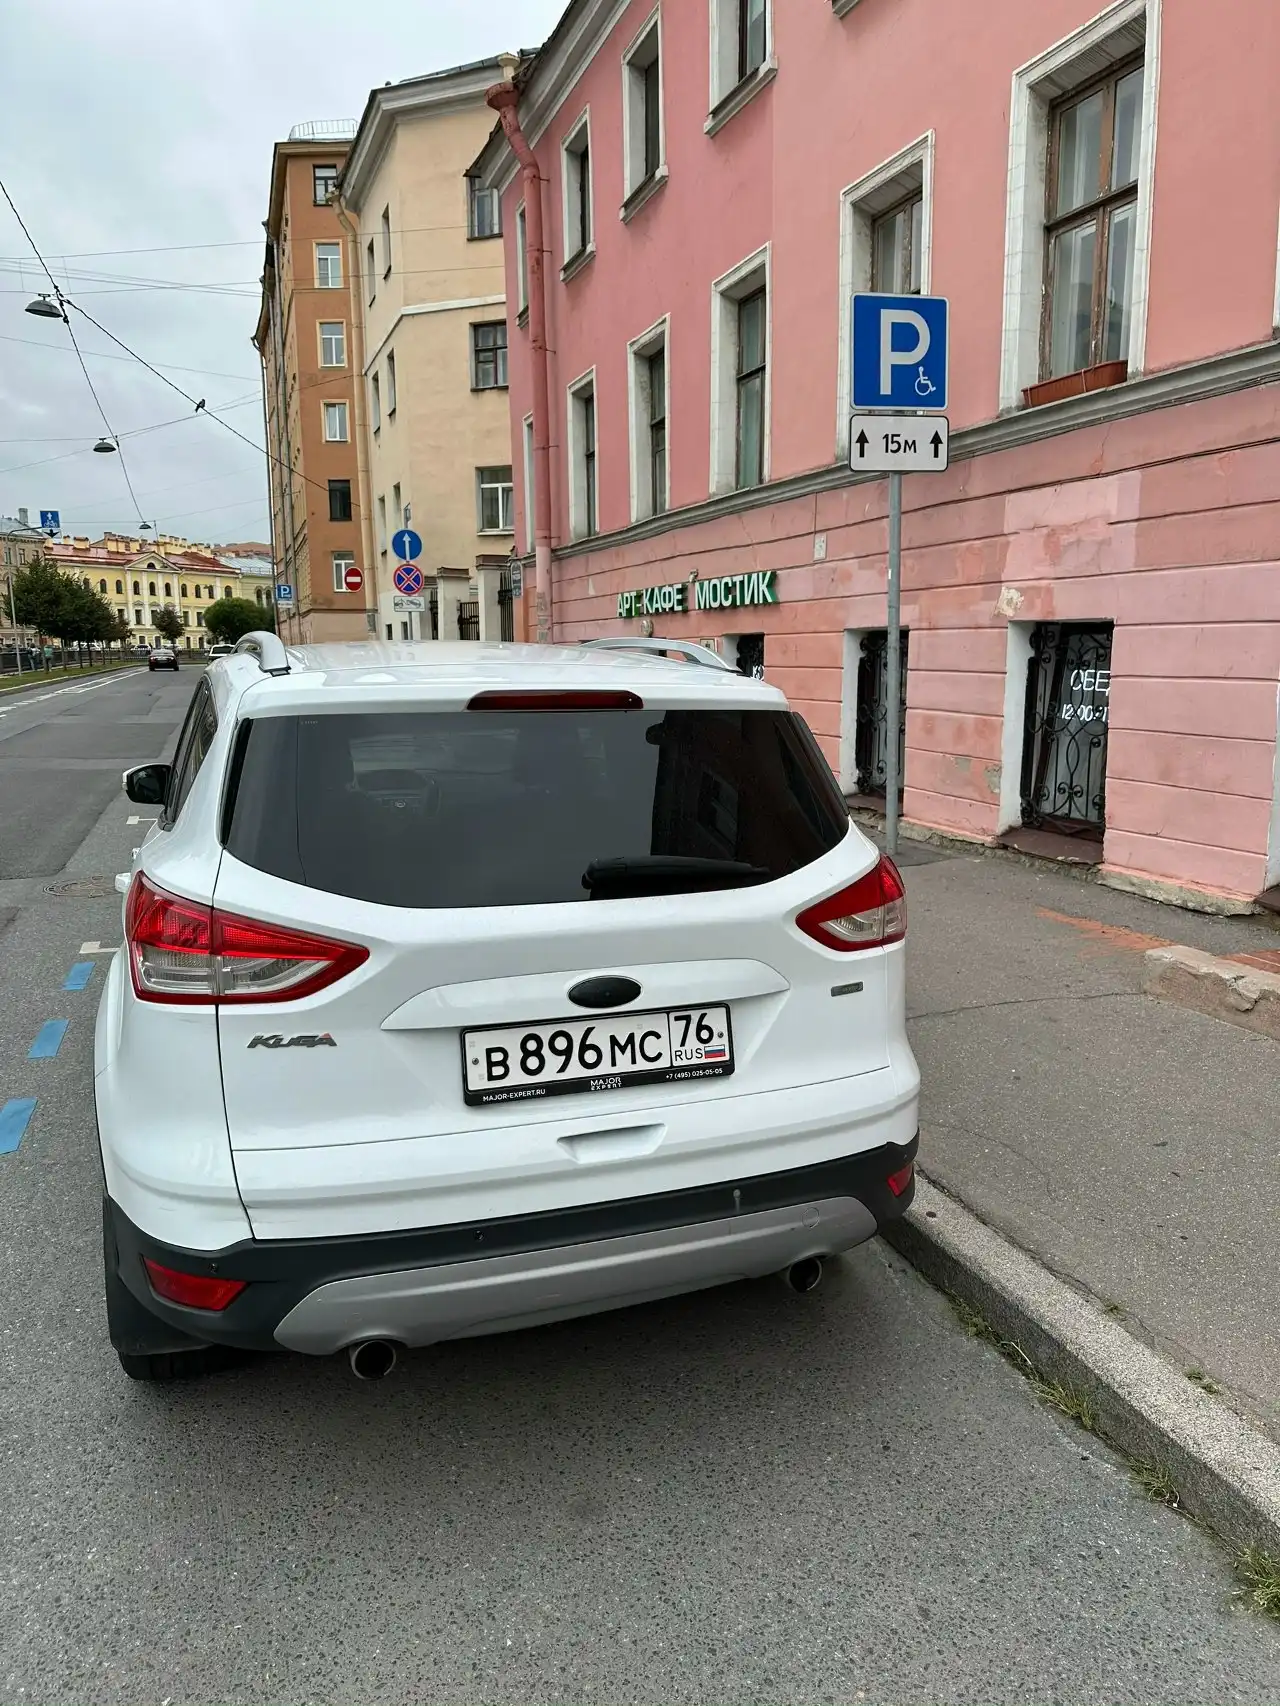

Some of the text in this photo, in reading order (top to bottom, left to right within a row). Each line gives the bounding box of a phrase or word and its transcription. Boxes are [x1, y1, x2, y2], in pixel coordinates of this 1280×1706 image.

[879, 308, 931, 395] P
[616, 571, 773, 617] АРТ-КАФЕ МОСТИК
[674, 1012, 714, 1048] 76
[674, 1049, 704, 1062] RUS
[590, 1076, 622, 1086] MAJOR
[590, 1082, 622, 1091] EXPERT
[482, 1088, 546, 1102] MAJOR-EXPERT.RU
